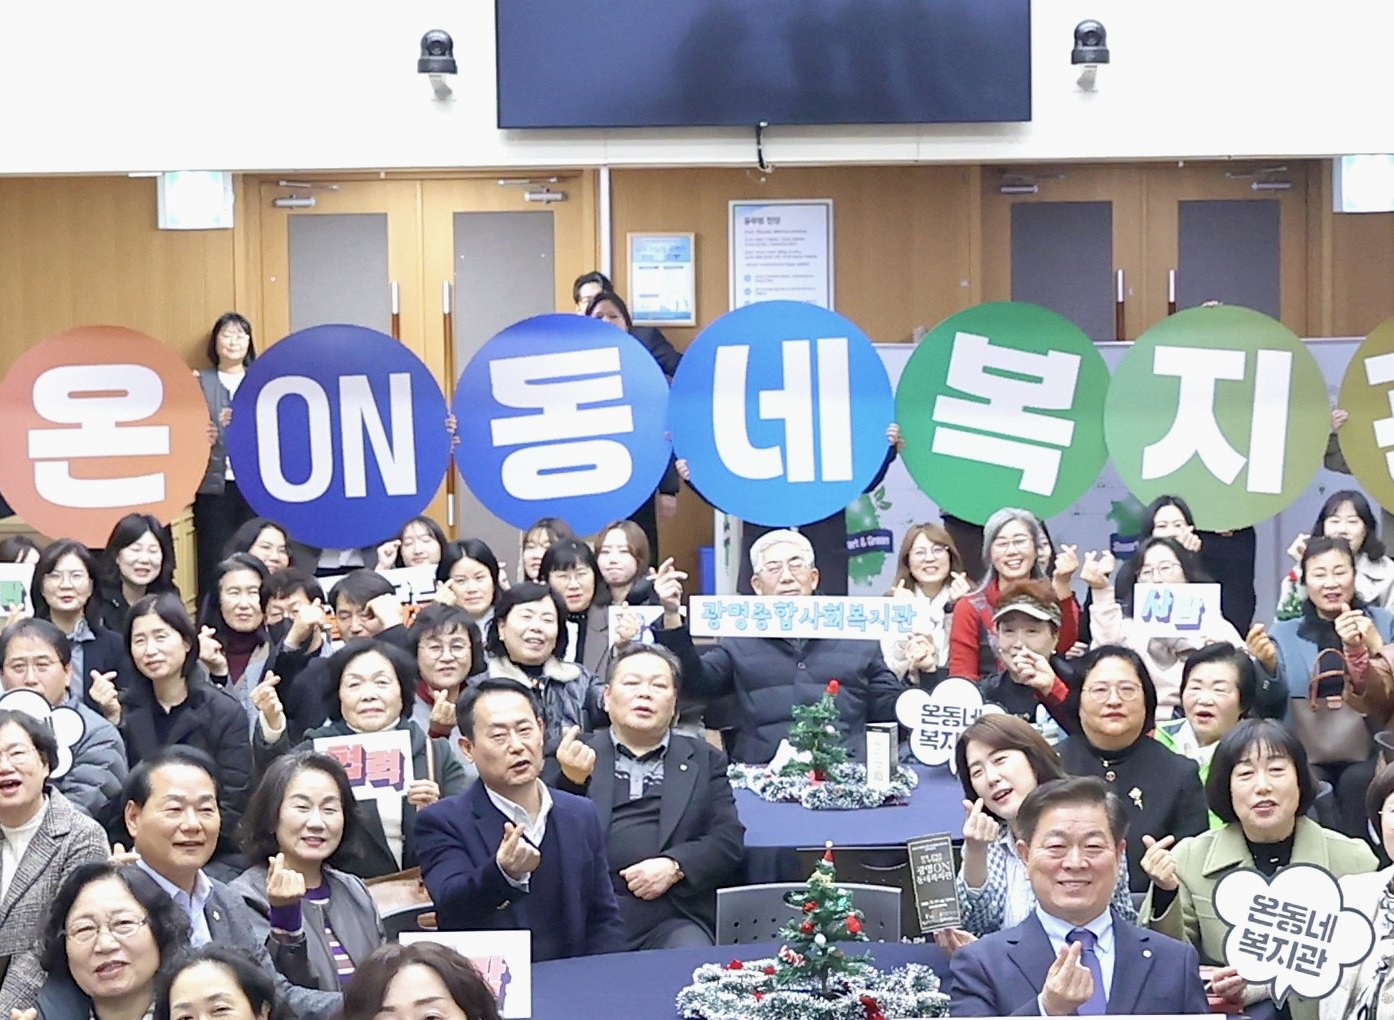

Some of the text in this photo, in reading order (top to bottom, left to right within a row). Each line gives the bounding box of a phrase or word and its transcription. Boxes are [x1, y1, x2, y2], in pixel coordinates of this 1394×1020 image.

[702, 601, 917, 633] 광명종합사회복지관
[1141, 588, 1206, 630] 사람
[921, 704, 982, 727] 온동네
[919, 729, 960, 751] 복지
[1247, 895, 1339, 940] 온동네
[1238, 926, 1327, 979] 복지관
